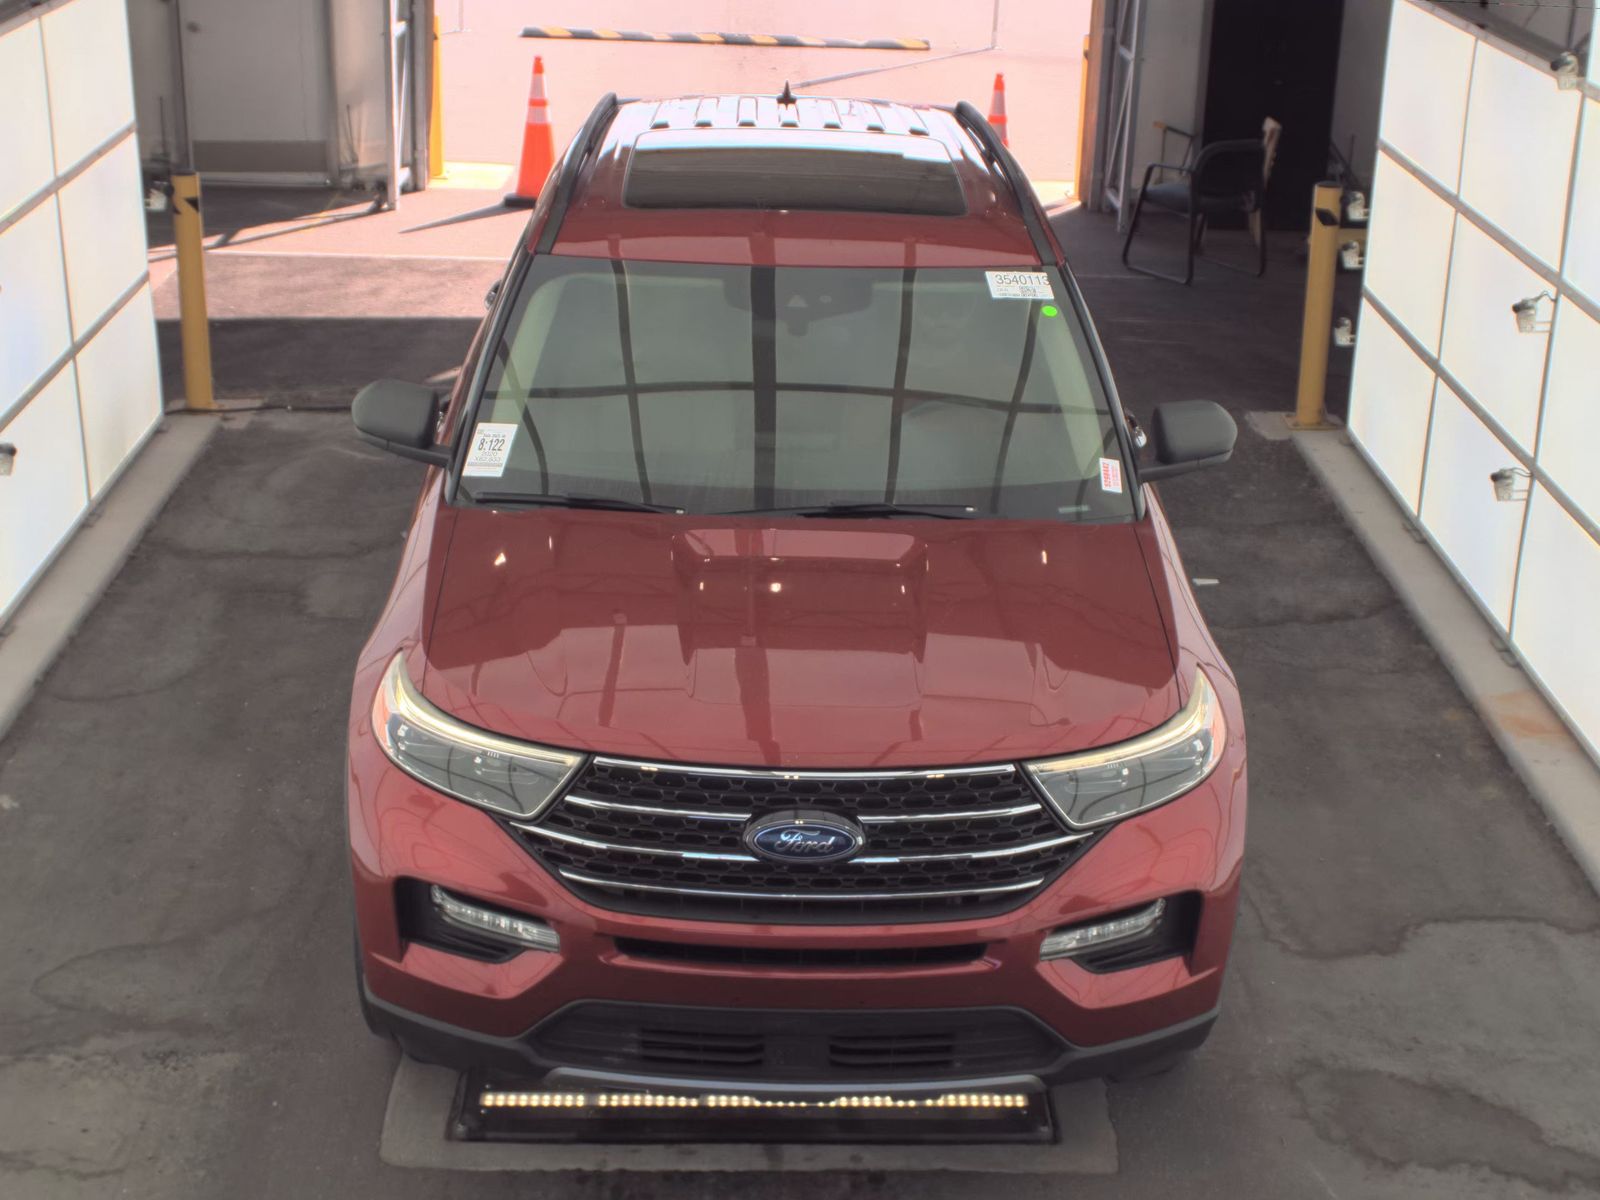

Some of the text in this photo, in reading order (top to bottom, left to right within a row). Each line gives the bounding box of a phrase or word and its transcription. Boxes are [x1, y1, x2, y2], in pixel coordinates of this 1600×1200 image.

[995, 273, 1050, 286] 3540113
[478, 437, 506, 452] 8:122
[775, 829, 836, 852] Ford
